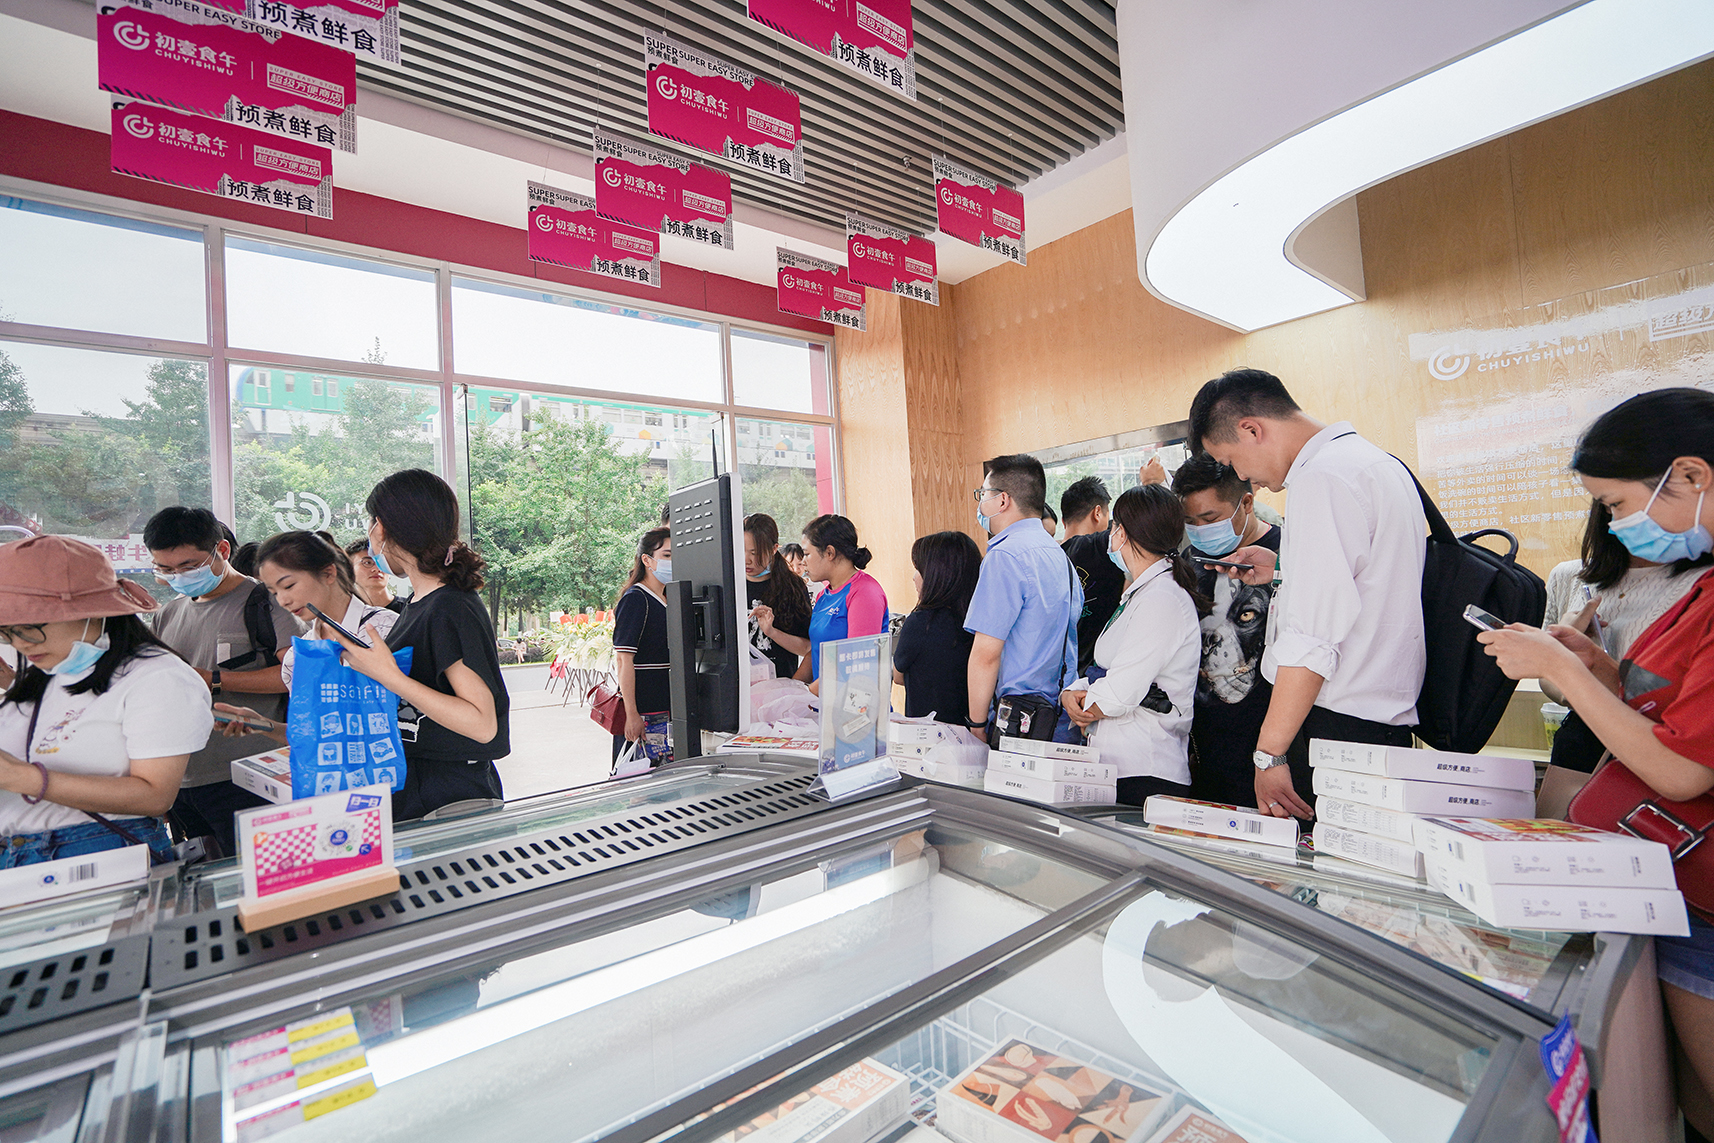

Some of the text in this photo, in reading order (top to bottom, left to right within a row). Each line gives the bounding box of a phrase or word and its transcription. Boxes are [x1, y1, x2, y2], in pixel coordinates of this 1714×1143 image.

[205, 9, 237, 25] EASY
[241, 20, 281, 40] STORE
[258, 1, 377, 54] 预煮鲜食
[155, 32, 237, 67] 初壹食午
[155, 50, 234, 76] CHUYISHIWU
[646, 37, 754, 86] SUPER SUPER EASY STORE
[838, 38, 904, 90] 预煮鲜食
[270, 74, 342, 102] 超级方便商店
[680, 84, 729, 112] 初壹食午
[680, 98, 728, 119] CHUYISHIWU
[158, 122, 228, 150] 初壹食午
[236, 101, 337, 146] 预煮鲜食
[158, 137, 225, 158] CHUYISHIWU
[595, 135, 689, 172] SUPER SUPER EASY STORE
[730, 140, 792, 176] 预煮鲜食
[257, 154, 319, 175] 超级方便商店
[227, 178, 314, 212] 预煮鲜食
[528, 186, 554, 198] SUPER
[556, 194, 578, 204] SUPER
[624, 173, 667, 194] 初壹食午
[624, 186, 666, 201] CHUYISHIWU
[556, 219, 597, 236] 初壹食午
[556, 230, 595, 242] CHUYISHIWU
[667, 219, 723, 246] 预煮鲜食
[984, 235, 1019, 260] 预煮鲜食
[597, 258, 649, 282] 预煮鲜食
[896, 282, 932, 302] 预煮鲜食
[824, 310, 859, 327] 预煮鲜食
[1477, 343, 1589, 372] CHUYISHIWU
